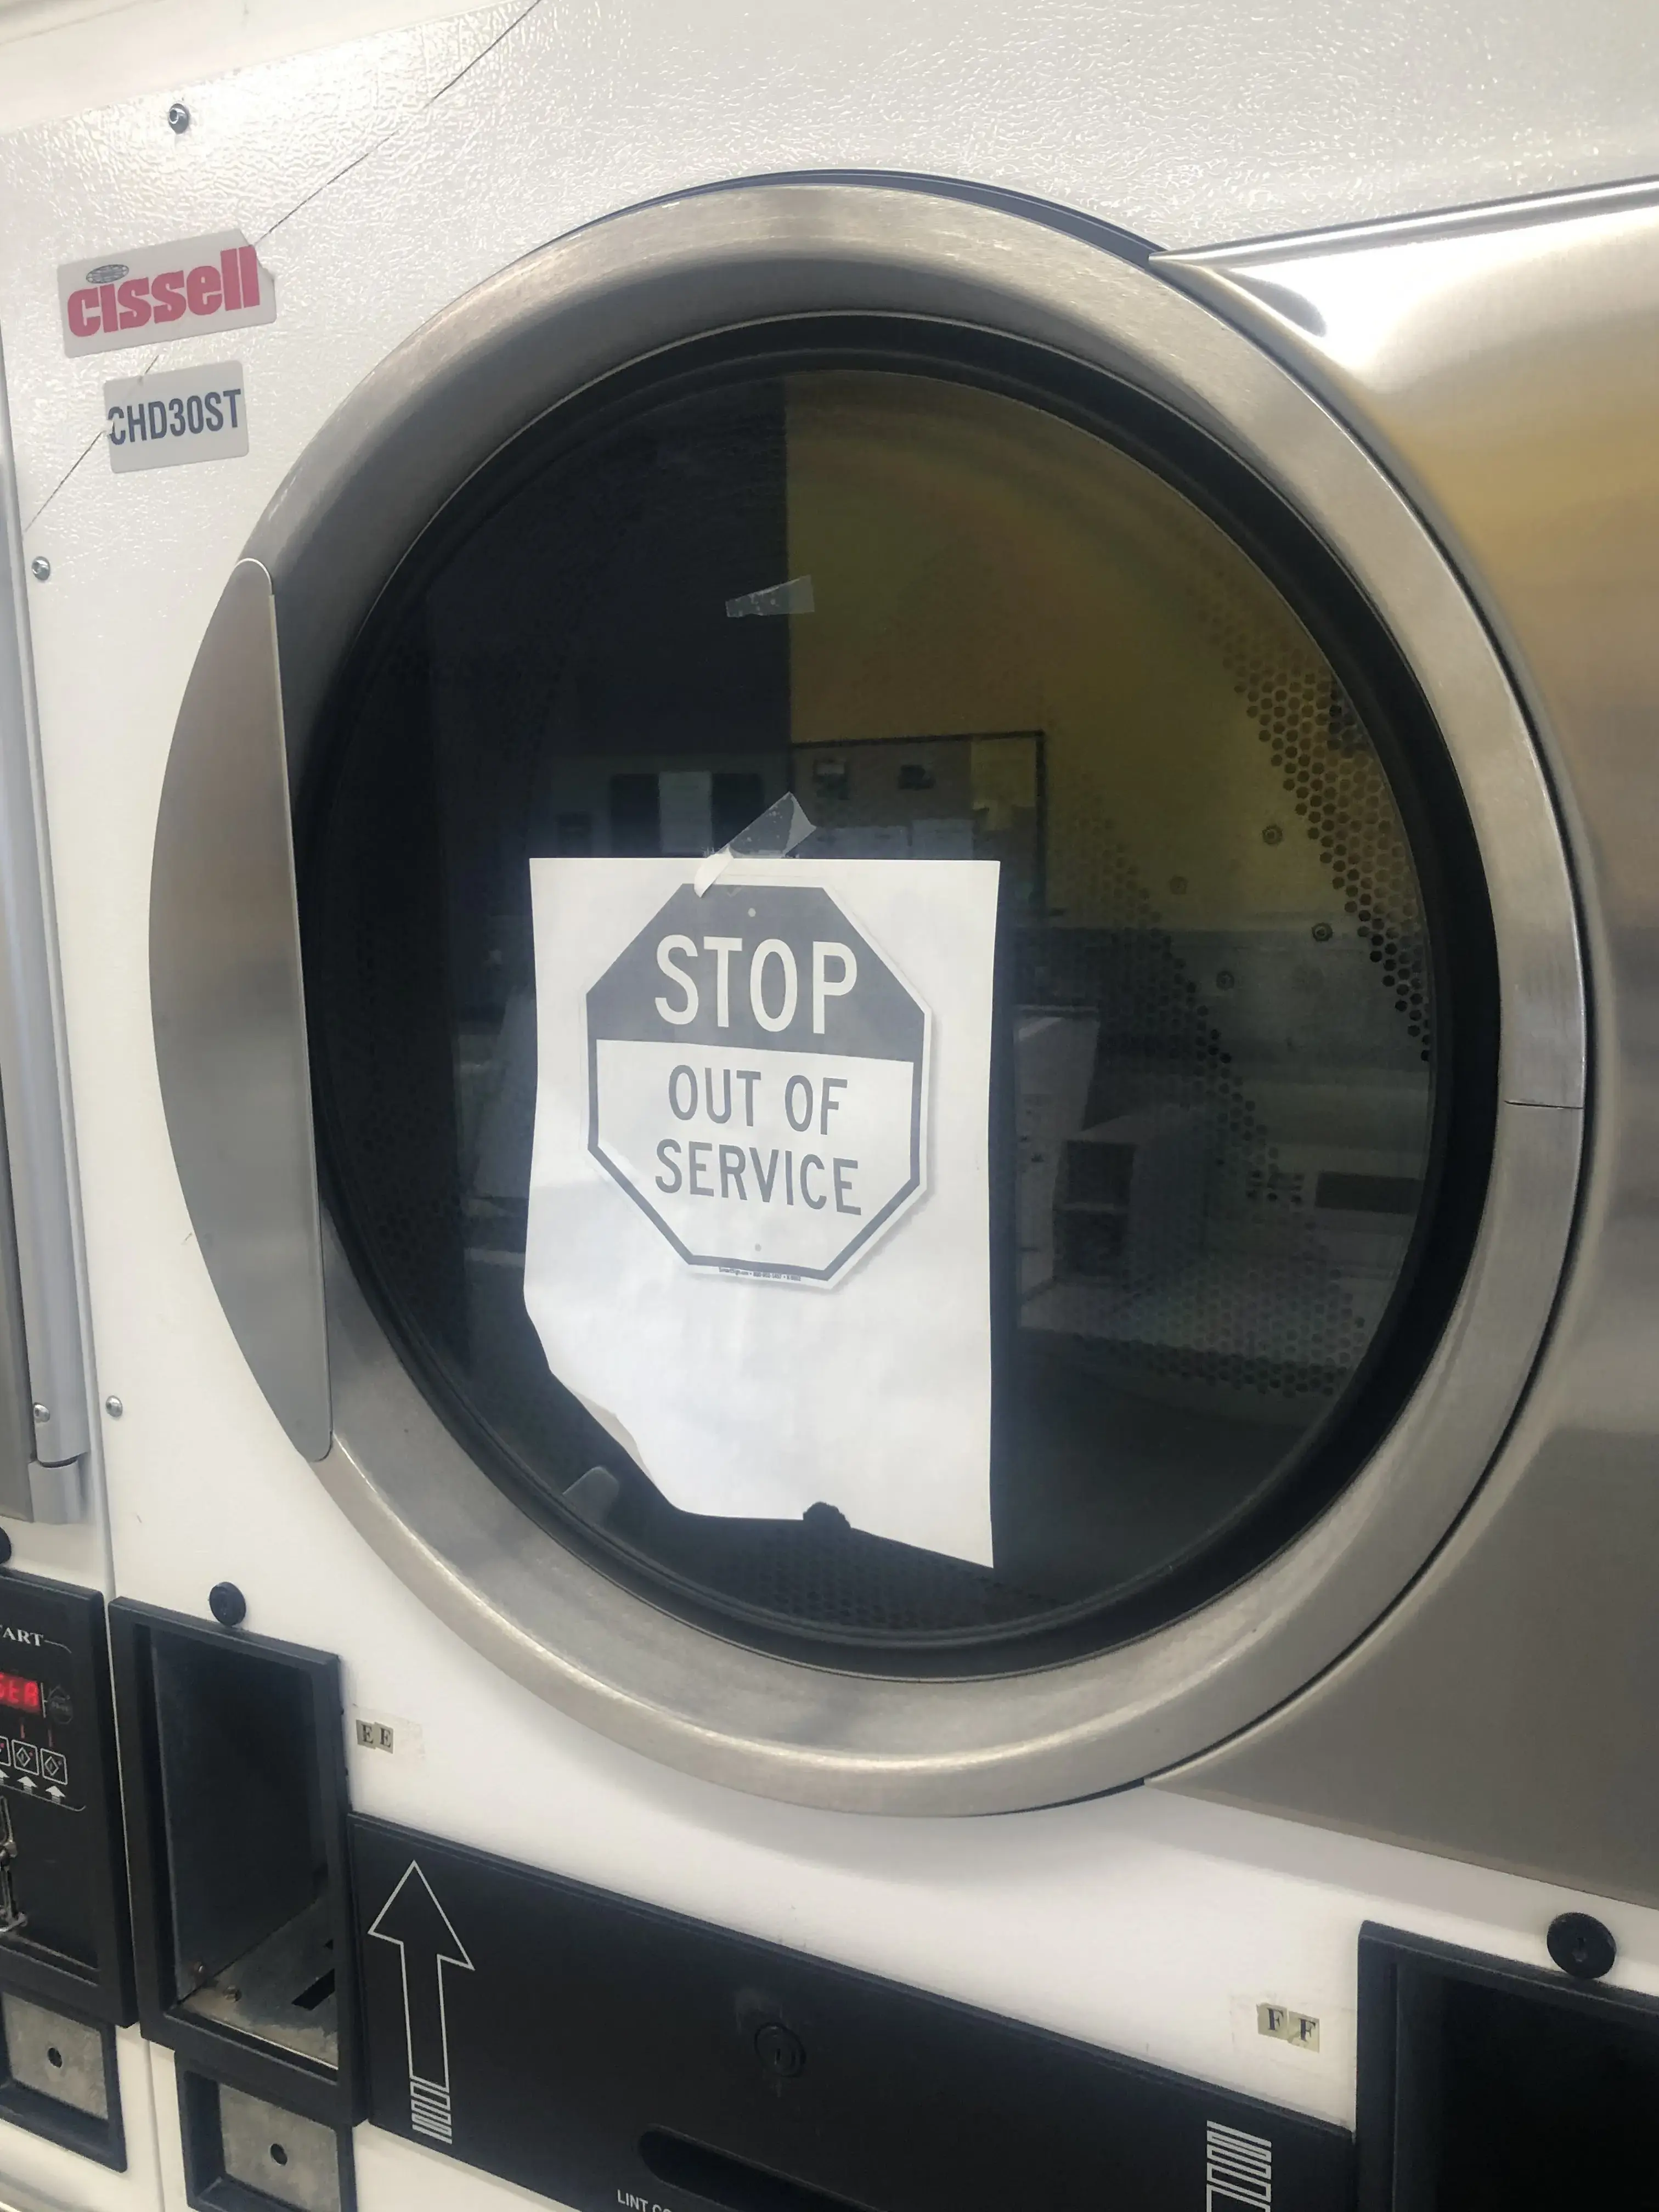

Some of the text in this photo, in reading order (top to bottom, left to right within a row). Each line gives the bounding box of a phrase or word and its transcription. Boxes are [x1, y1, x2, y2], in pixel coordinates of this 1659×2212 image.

[108, 388, 241, 445] CHD30ST
[655, 934, 857, 1034] STOP
[668, 1064, 848, 1135] OUT OF
[655, 1138, 861, 1215] SERVICE
[0, 1624, 44, 1646] ART
[617, 2189, 649, 2212] LINT
